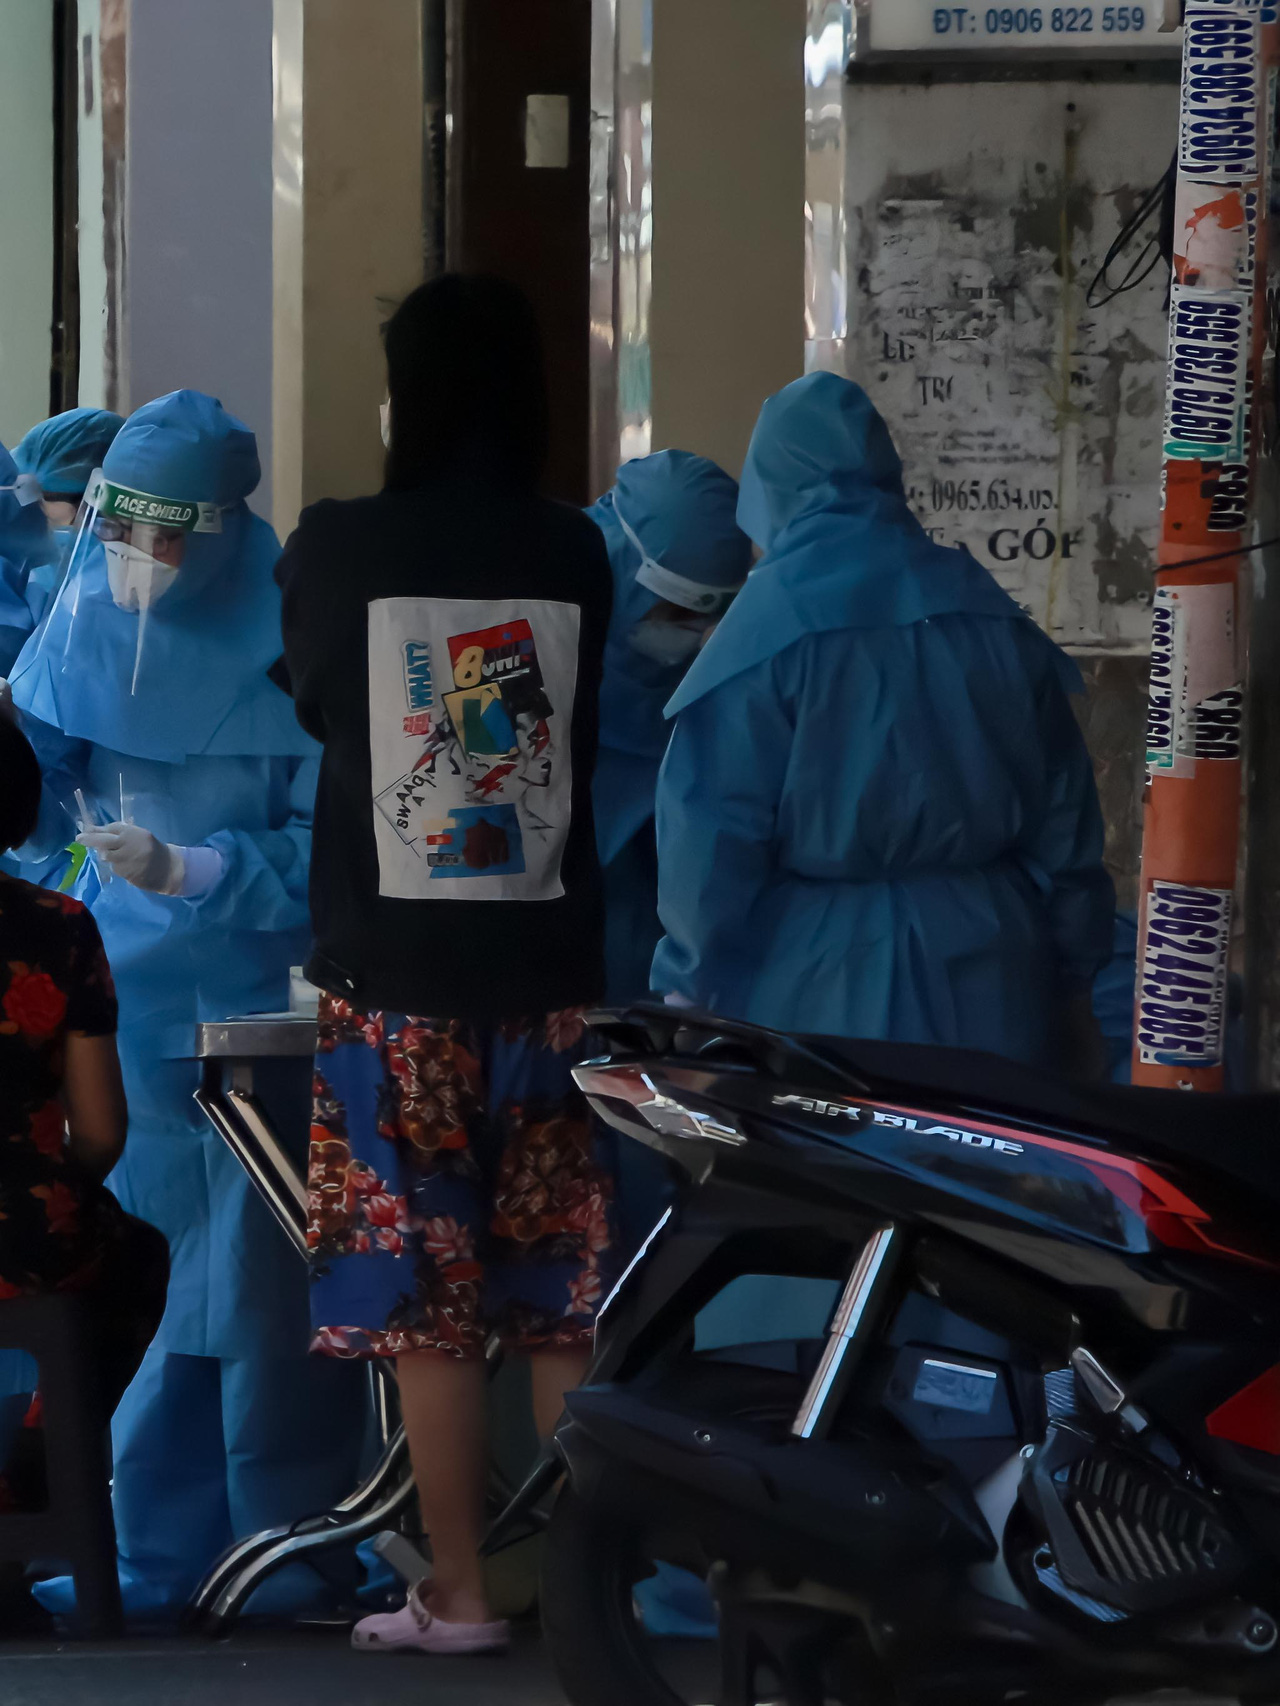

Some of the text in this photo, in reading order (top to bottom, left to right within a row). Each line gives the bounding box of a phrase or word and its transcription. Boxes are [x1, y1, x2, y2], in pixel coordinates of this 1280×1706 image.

[933, 7, 1144, 33] ĐT: 0906 822 559
[1189, 19, 1256, 162] 0934.386.599
[1170, 301, 1242, 443] 0979.739.559
[114, 494, 192, 521] FACE SHIELD
[1138, 887, 1222, 1053] 0962.445.885
[771, 1094, 1024, 1156] AIR BLADE
